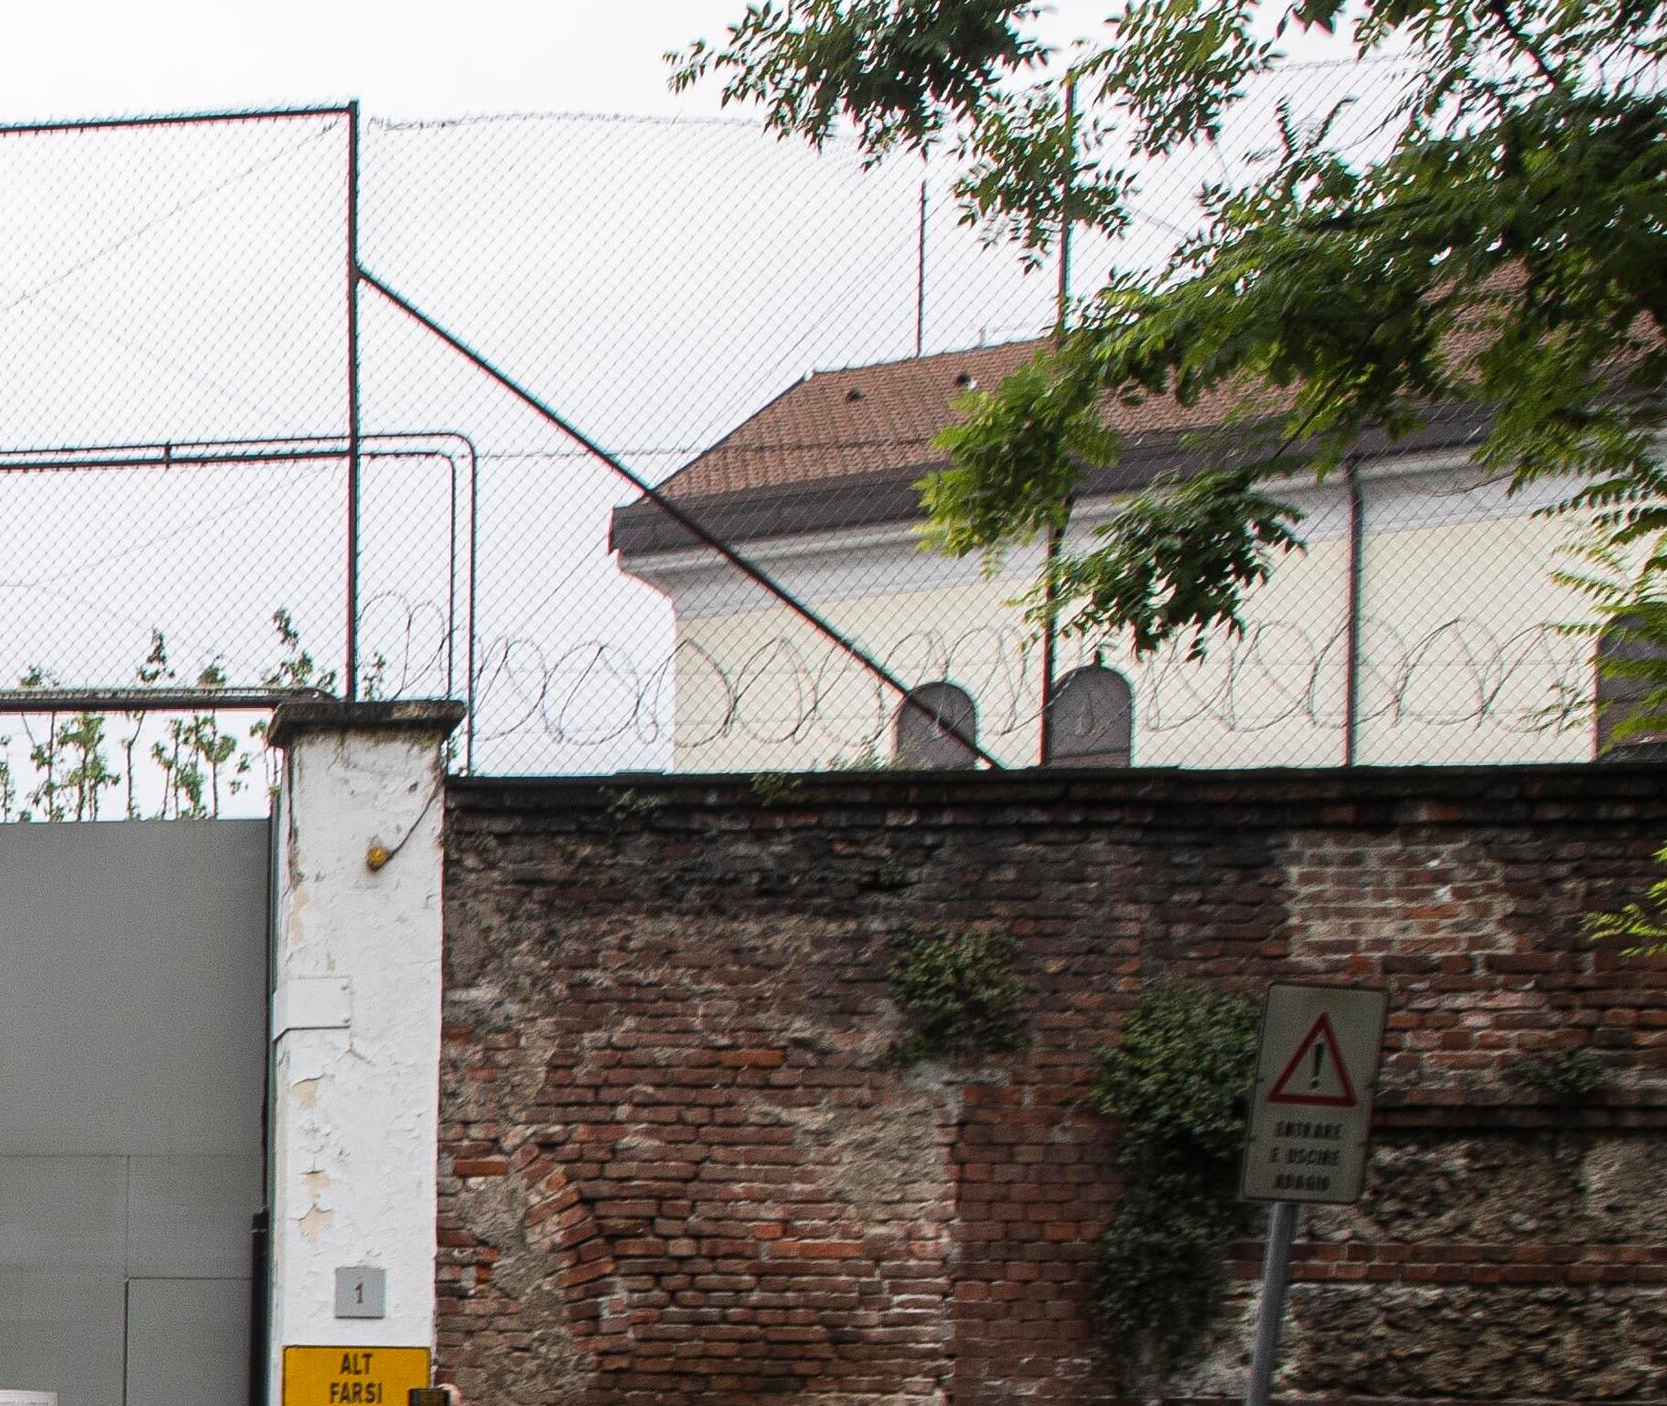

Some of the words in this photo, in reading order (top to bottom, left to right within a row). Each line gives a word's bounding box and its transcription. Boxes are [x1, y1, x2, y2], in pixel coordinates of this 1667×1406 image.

[353, 1281, 365, 1305] 1
[339, 1352, 373, 1375] ALT
[329, 1381, 383, 1404] FARSI
